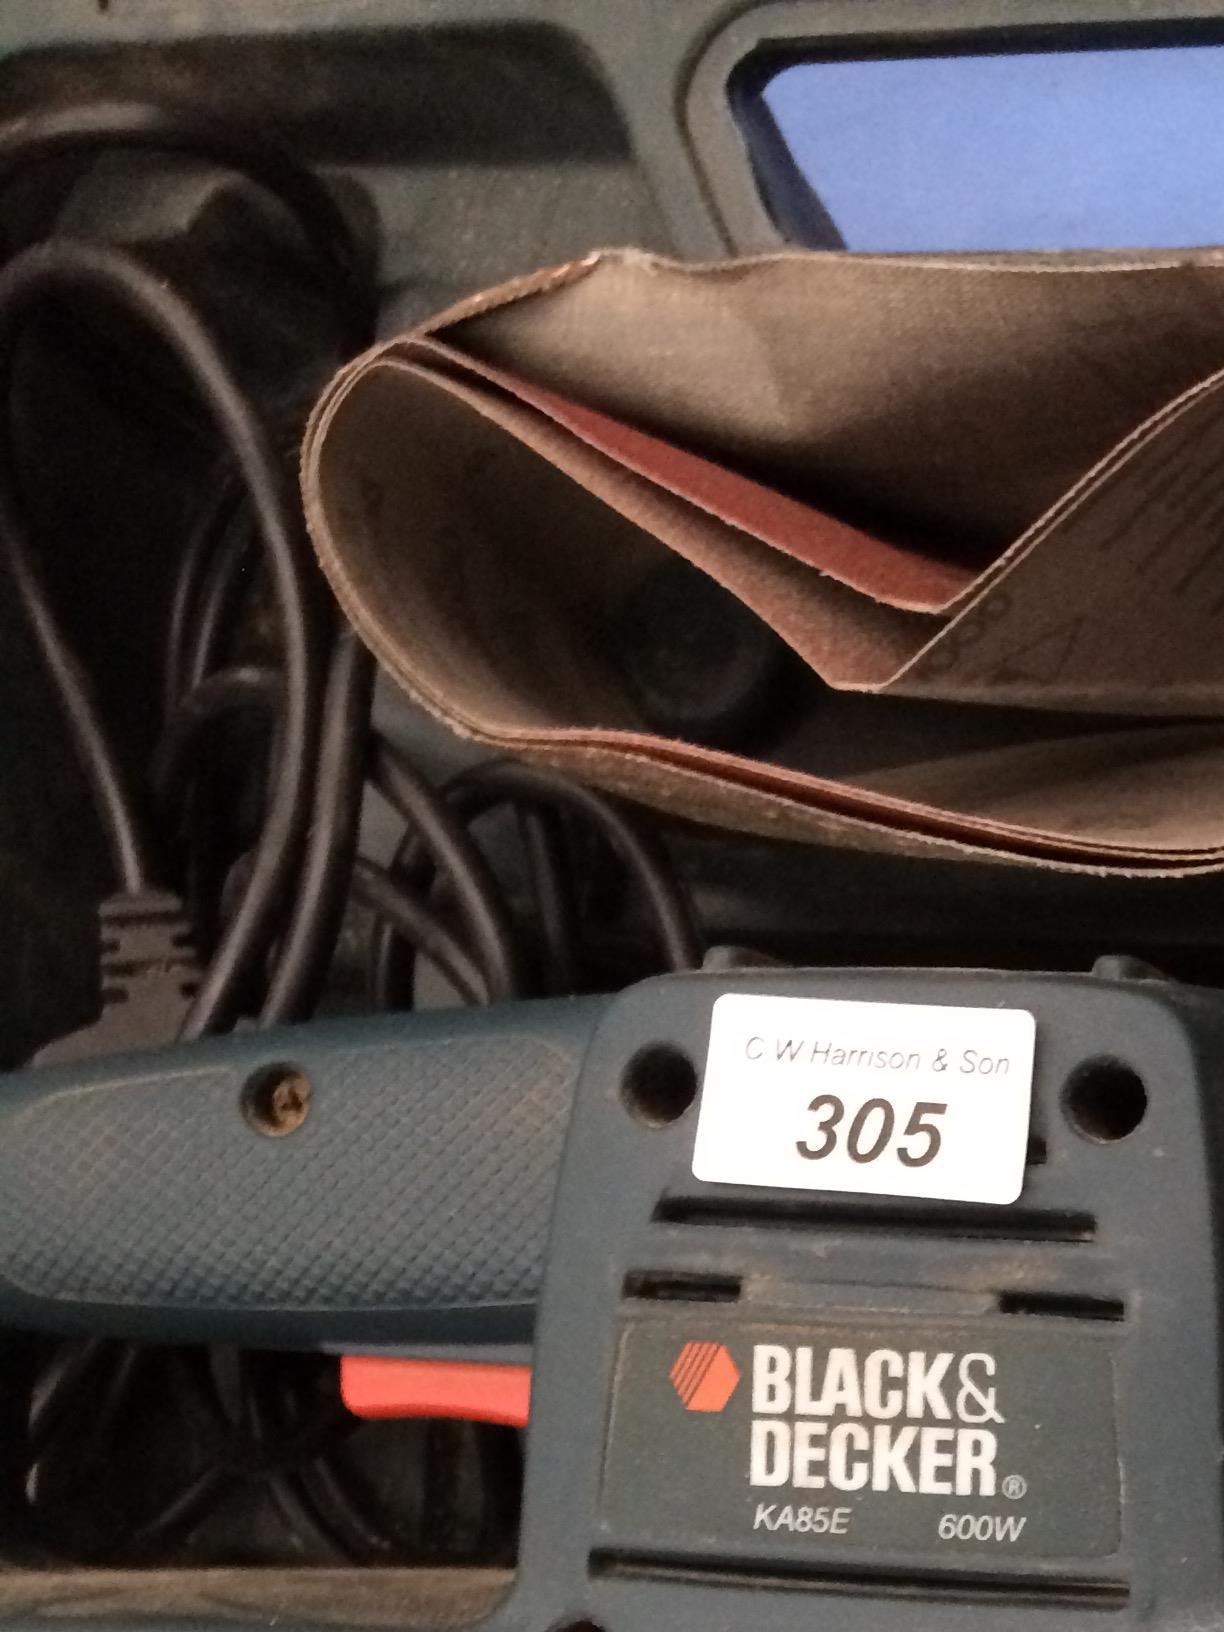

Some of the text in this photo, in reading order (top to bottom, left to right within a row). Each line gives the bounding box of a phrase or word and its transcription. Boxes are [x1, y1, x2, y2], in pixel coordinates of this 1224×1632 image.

[745, 1036, 1011, 1075] C W Harrison & Son
[795, 1094, 948, 1168] 305
[753, 1503, 1028, 1543] KA85E 600W
